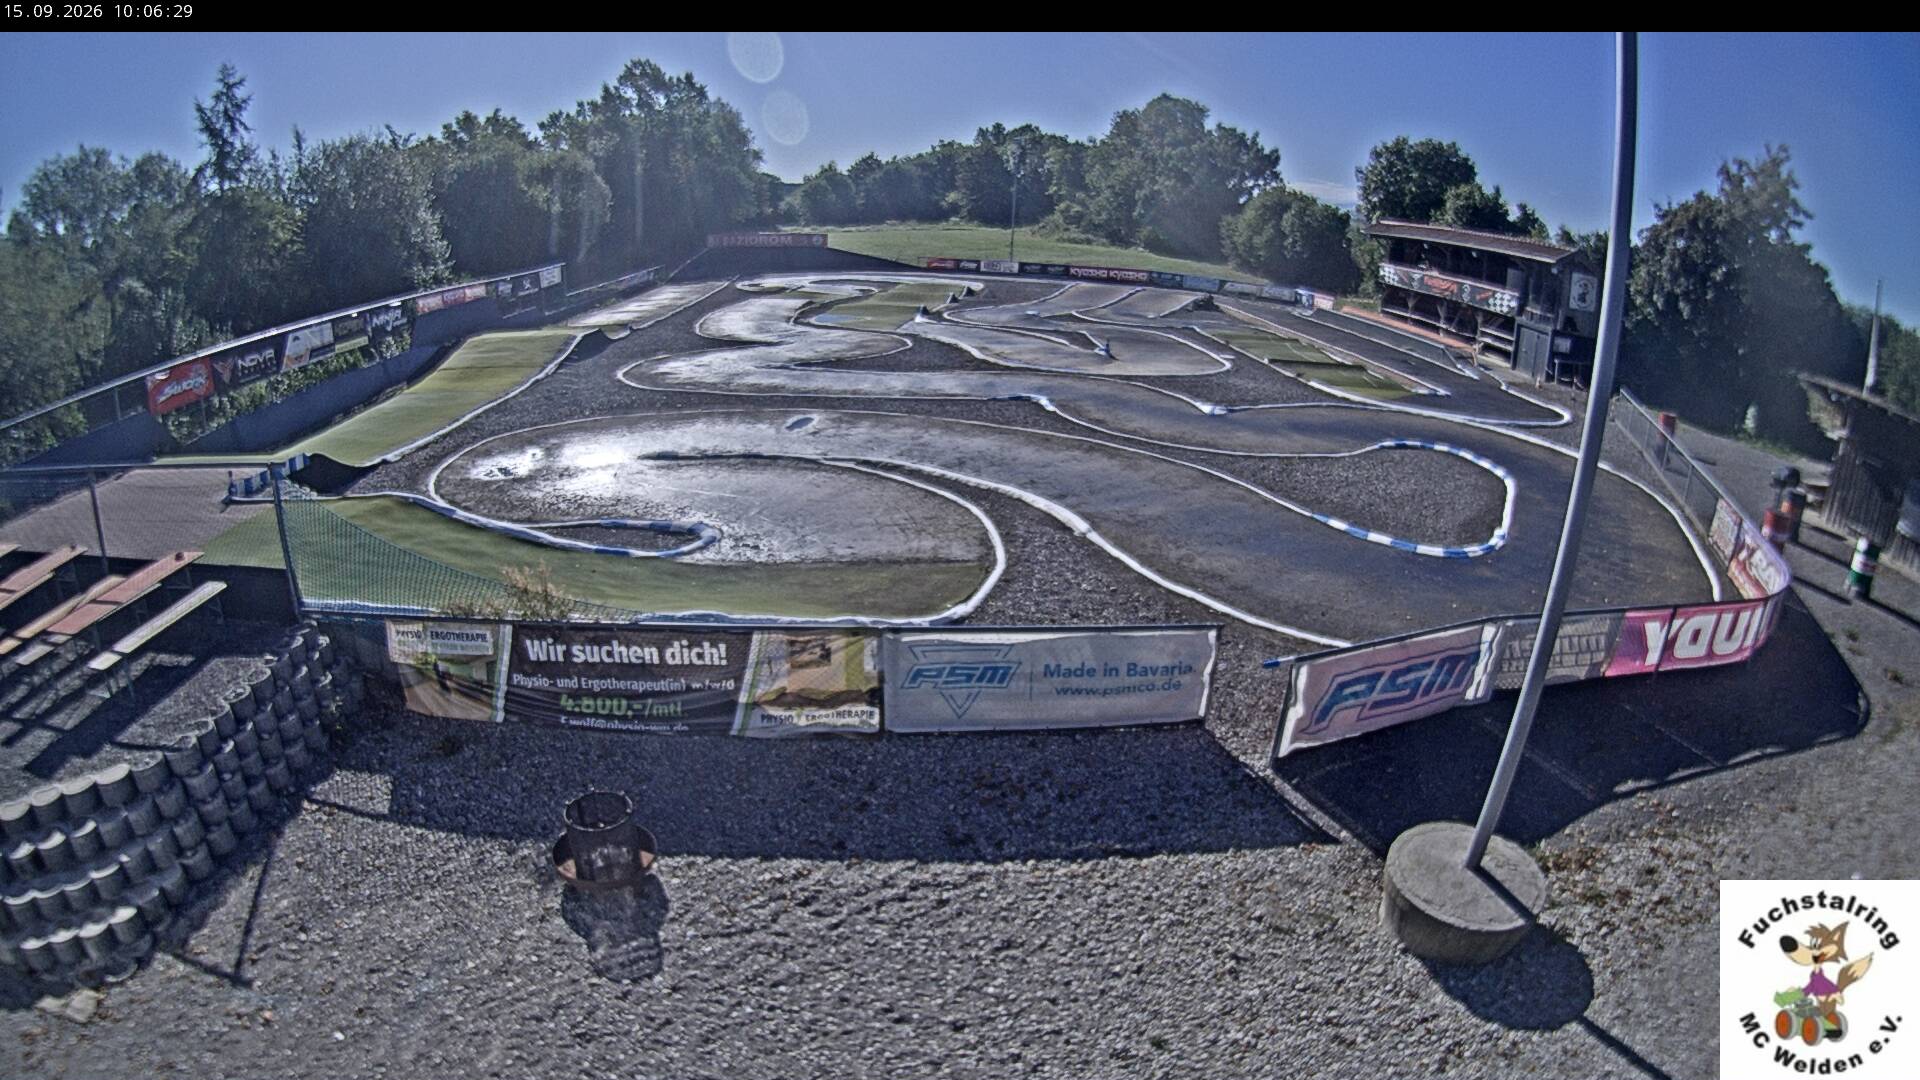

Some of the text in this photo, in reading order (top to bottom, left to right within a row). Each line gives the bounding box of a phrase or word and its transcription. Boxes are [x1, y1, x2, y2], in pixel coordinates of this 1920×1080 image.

[429, 630, 489, 643] ERGOTHERAPIE
[525, 638, 728, 666] Wir suchen dich!
[1043, 662, 1100, 679] Made
[1103, 662, 1120, 678] in
[512, 674, 554, 688] Physio-
[557, 675, 578, 689] und
[581, 677, 687, 693] Ergotherapeut(in)
[760, 713, 794, 725] PHYSIO
